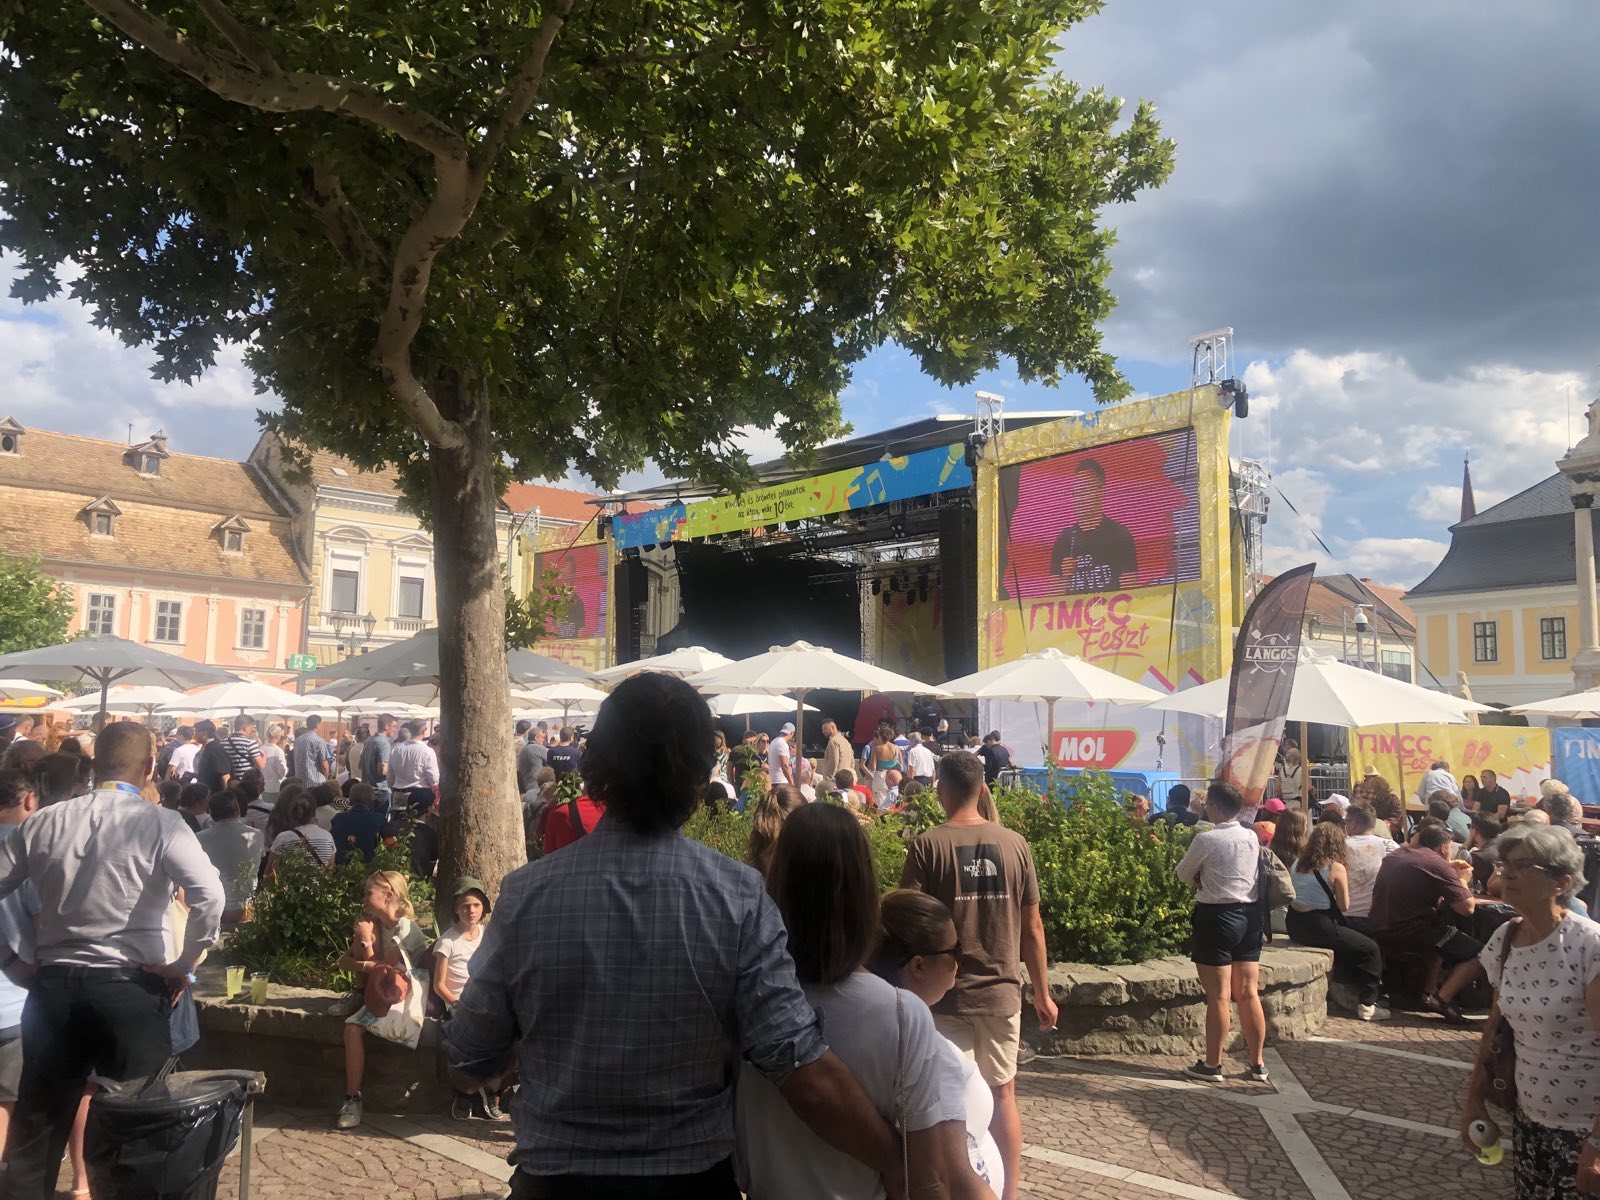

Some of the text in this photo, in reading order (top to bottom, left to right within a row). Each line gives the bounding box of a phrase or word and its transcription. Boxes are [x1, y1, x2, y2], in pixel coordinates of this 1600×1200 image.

[748, 494, 755, 505] és
[774, 501, 784, 518] 10
[1057, 593, 1133, 630] MCC
[1077, 623, 1150, 658] Feszt
[1058, 736, 1106, 761] MOL
[1379, 734, 1432, 756] MCC
